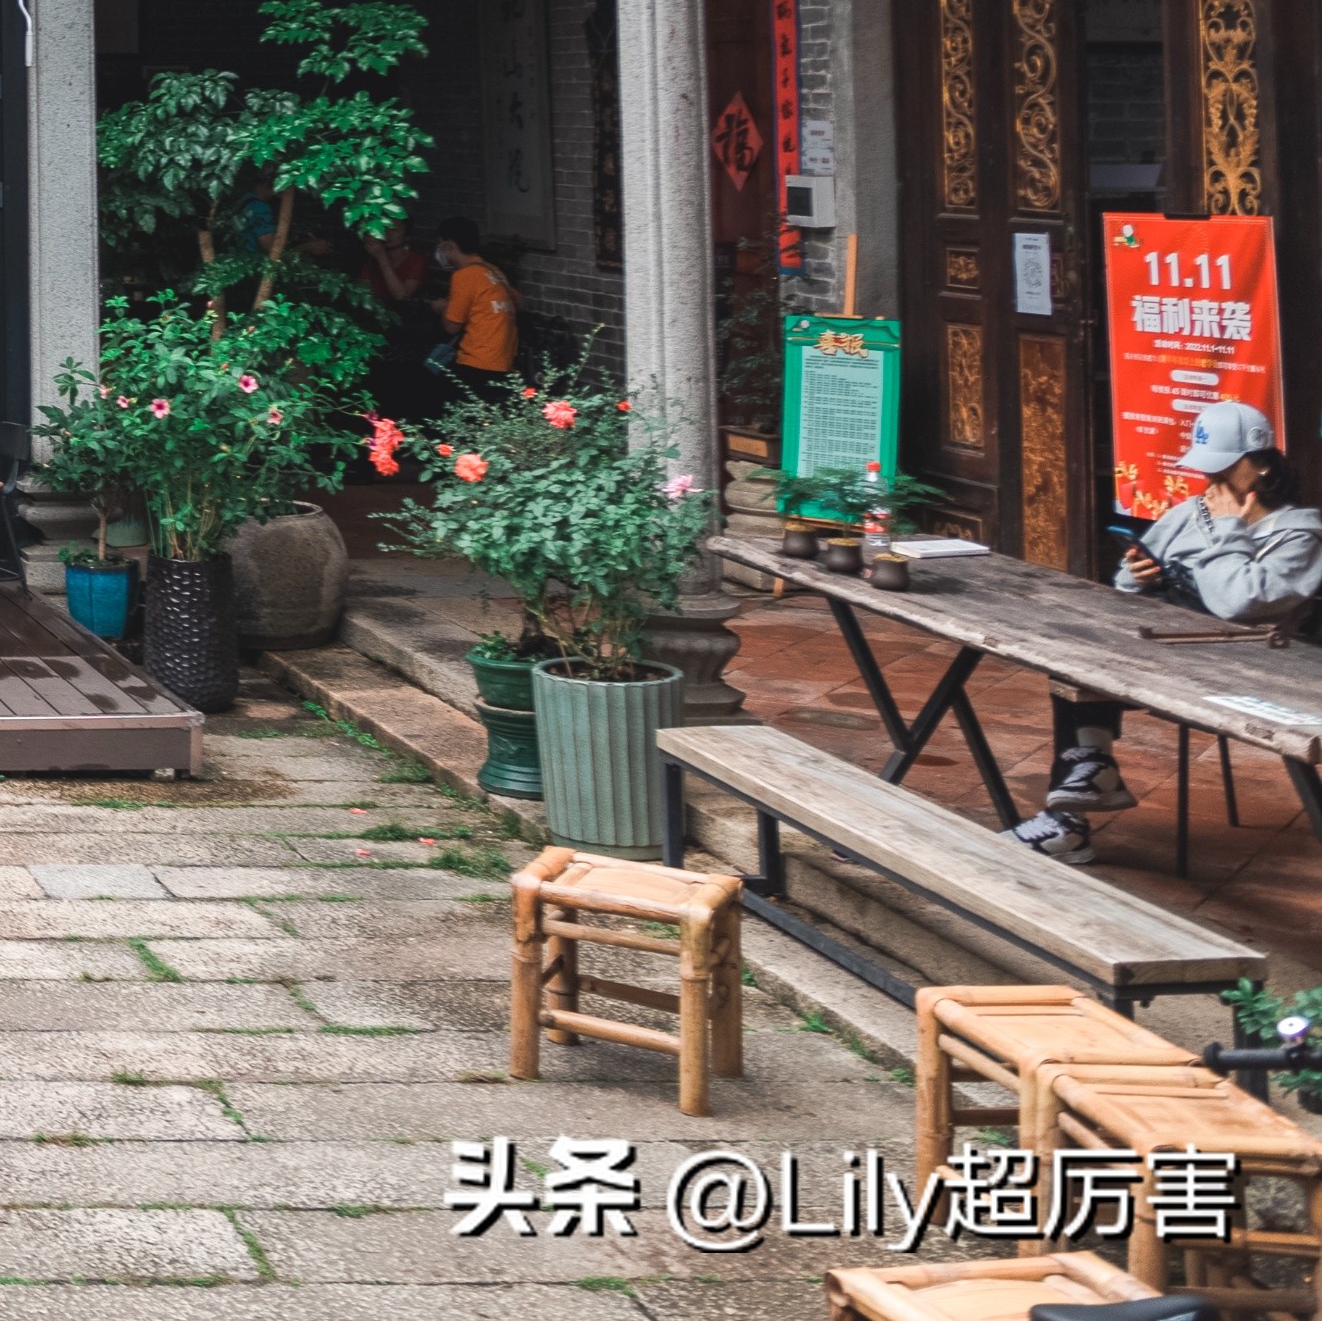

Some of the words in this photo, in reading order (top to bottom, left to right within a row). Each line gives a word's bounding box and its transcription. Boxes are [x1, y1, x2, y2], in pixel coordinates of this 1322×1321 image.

[1144, 251, 1232, 290] 11.11
[1130, 294, 1252, 341] 福利来袭
